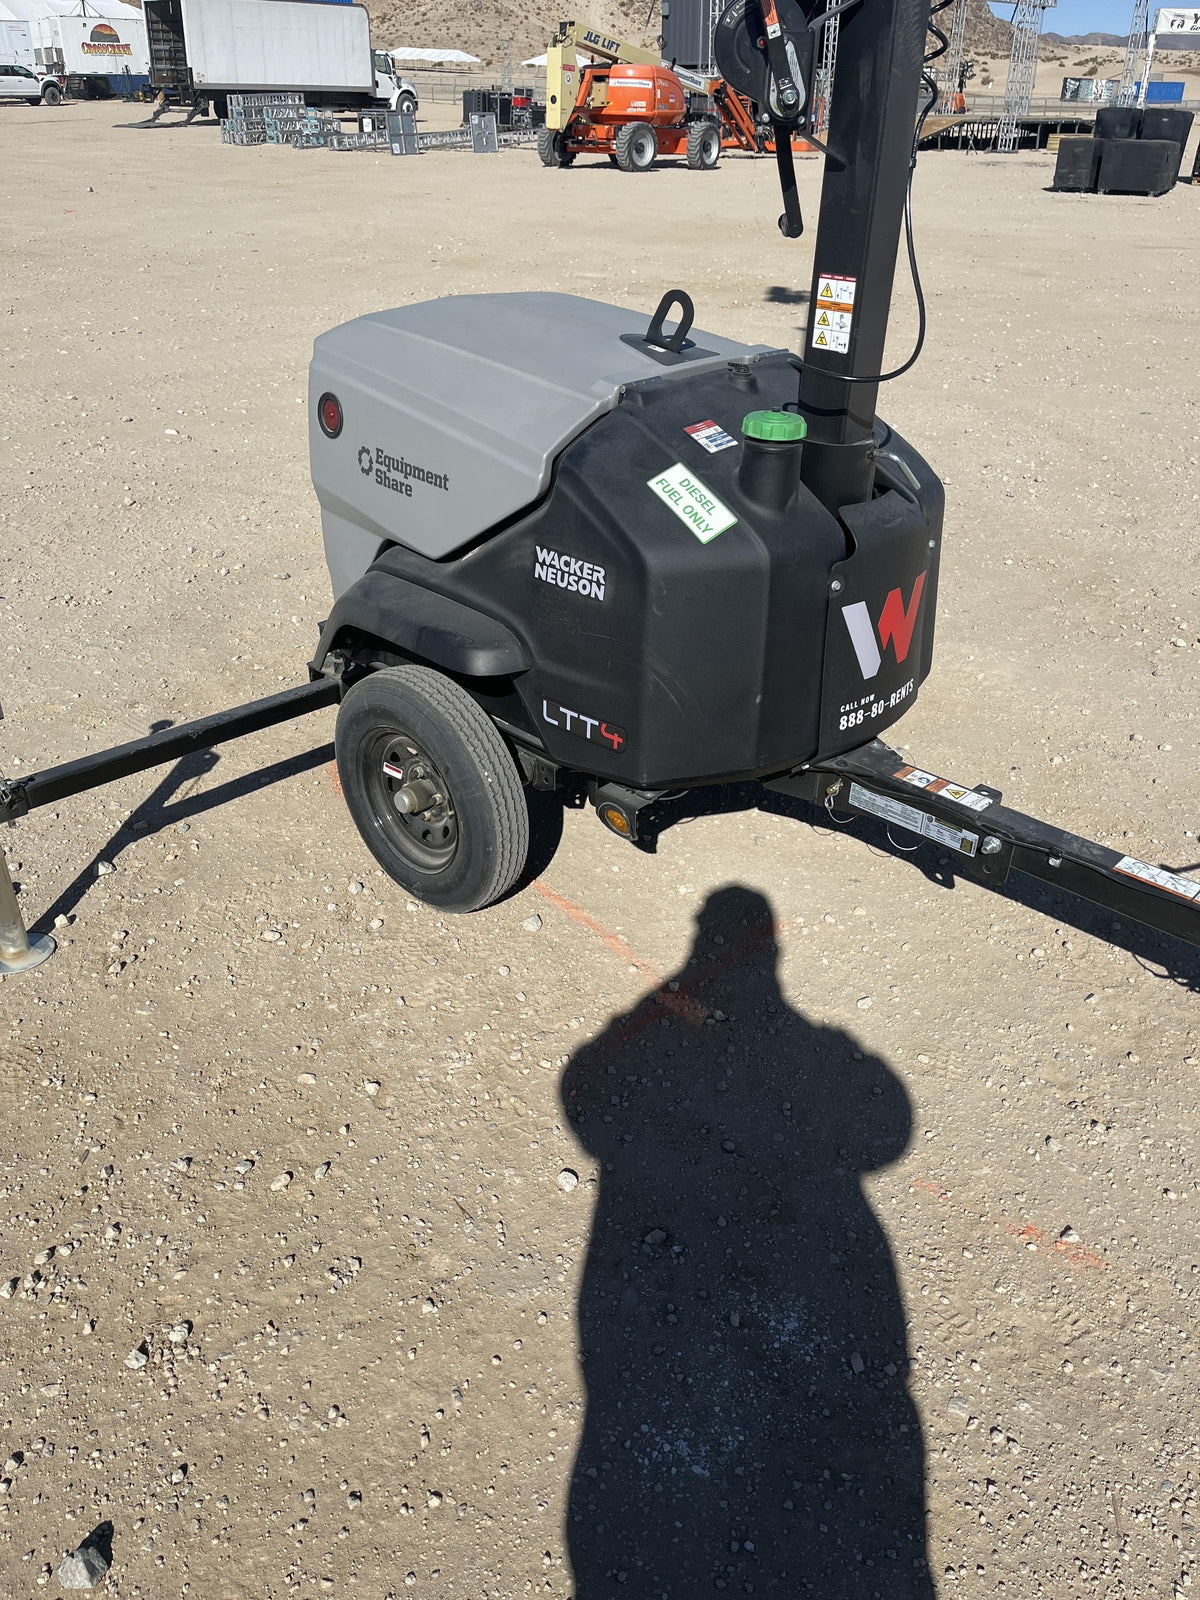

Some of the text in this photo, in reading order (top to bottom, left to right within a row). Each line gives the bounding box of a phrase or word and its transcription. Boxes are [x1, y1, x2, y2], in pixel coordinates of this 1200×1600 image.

[81, 42, 133, 55] CROSSCREEK
[584, 30, 621, 53] JLG LIFT
[375, 447, 450, 491] Equipment
[375, 468, 413, 497] Share
[655, 478, 714, 534] FUEL ONLY
[678, 478, 717, 516] DIESEL
[534, 562, 606, 601] NEUSON
[535, 545, 606, 585] WACKER
[839, 678, 914, 731] 888-80-RENTS
[840, 693, 876, 713] CALL NOW
[542, 699, 624, 750] LTT4
